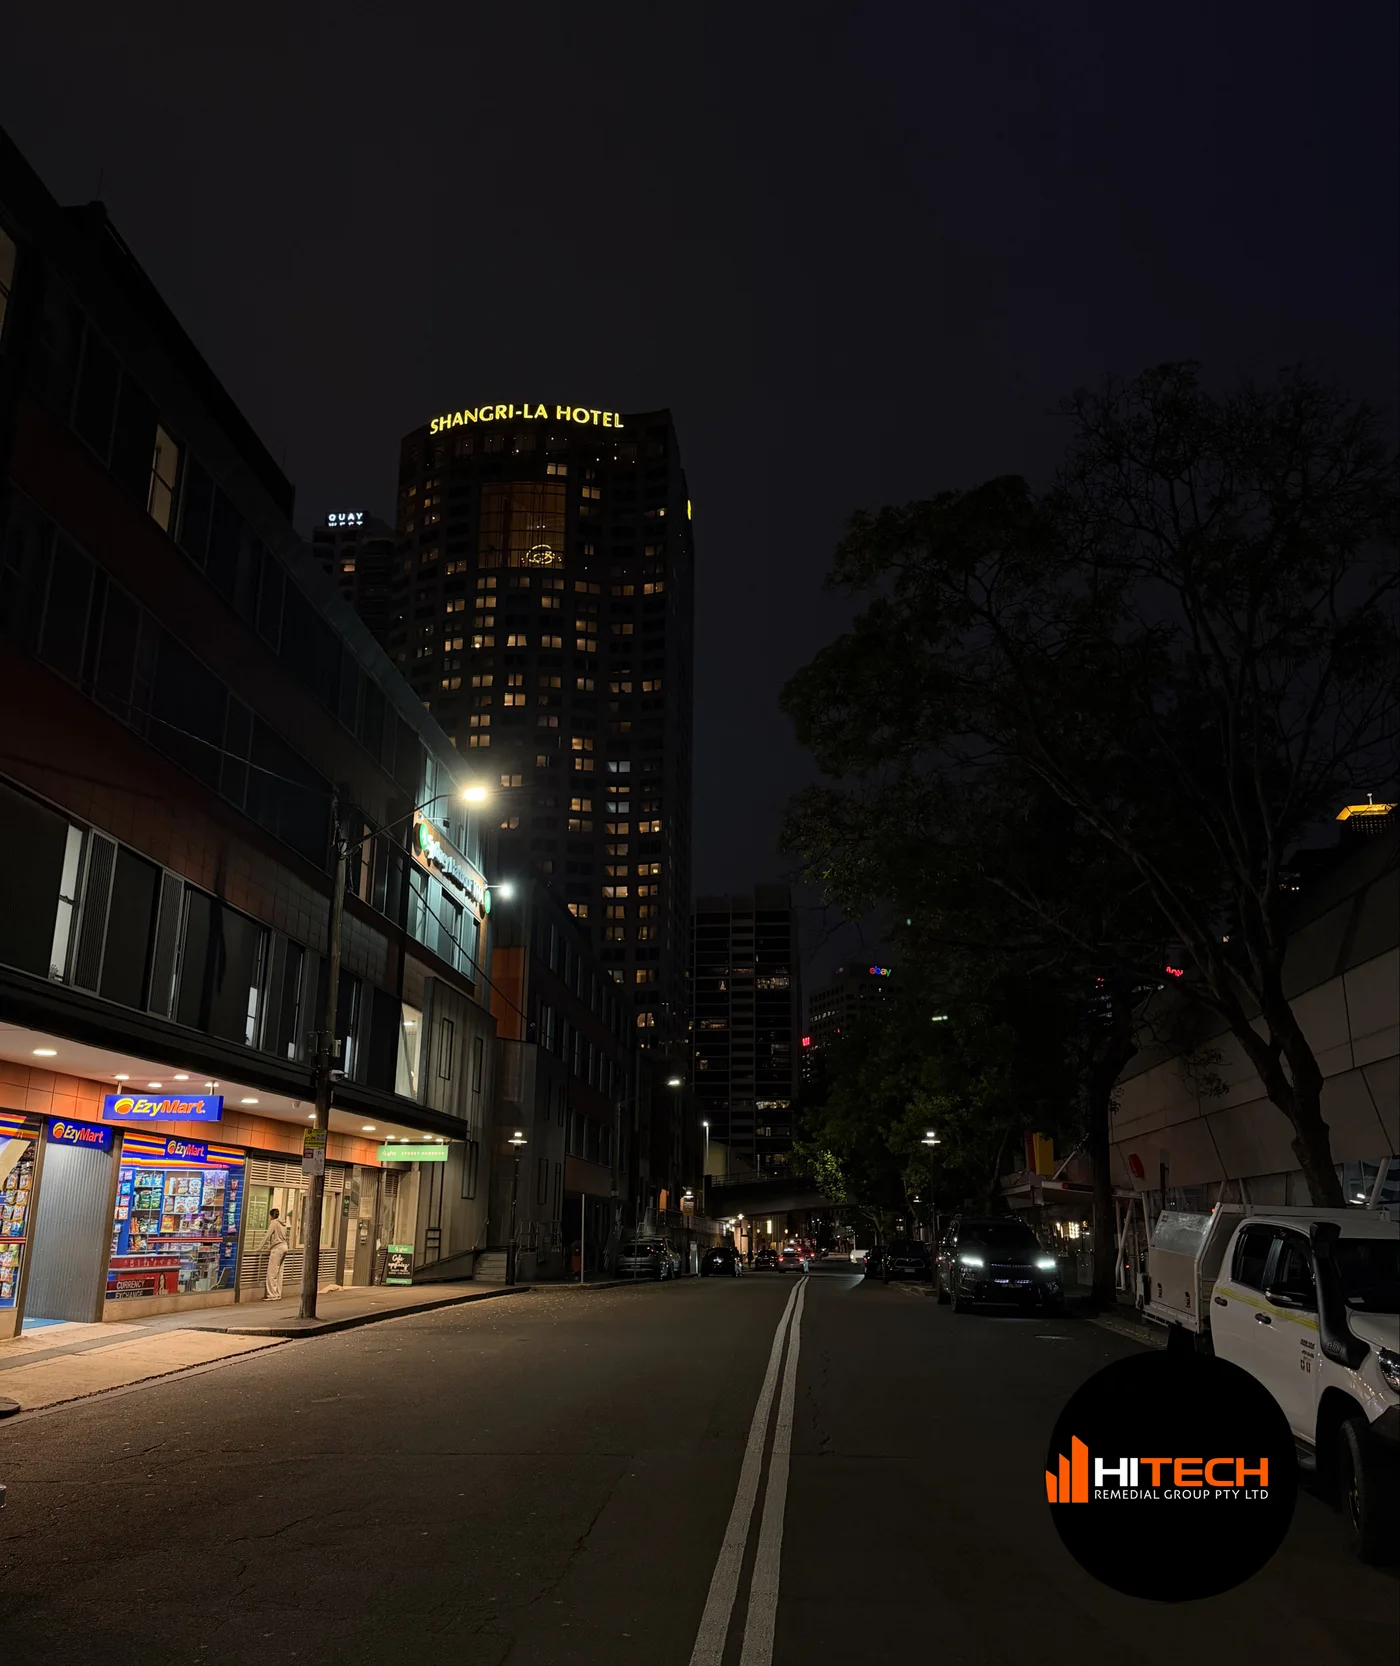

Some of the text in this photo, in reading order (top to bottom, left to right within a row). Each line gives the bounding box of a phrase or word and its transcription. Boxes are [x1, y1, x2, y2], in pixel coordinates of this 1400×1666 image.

[429, 403, 624, 435] SHANGRI-LA HOTEL
[328, 512, 363, 522] QUAY
[116, 1280, 145, 1290] CURRENCY
